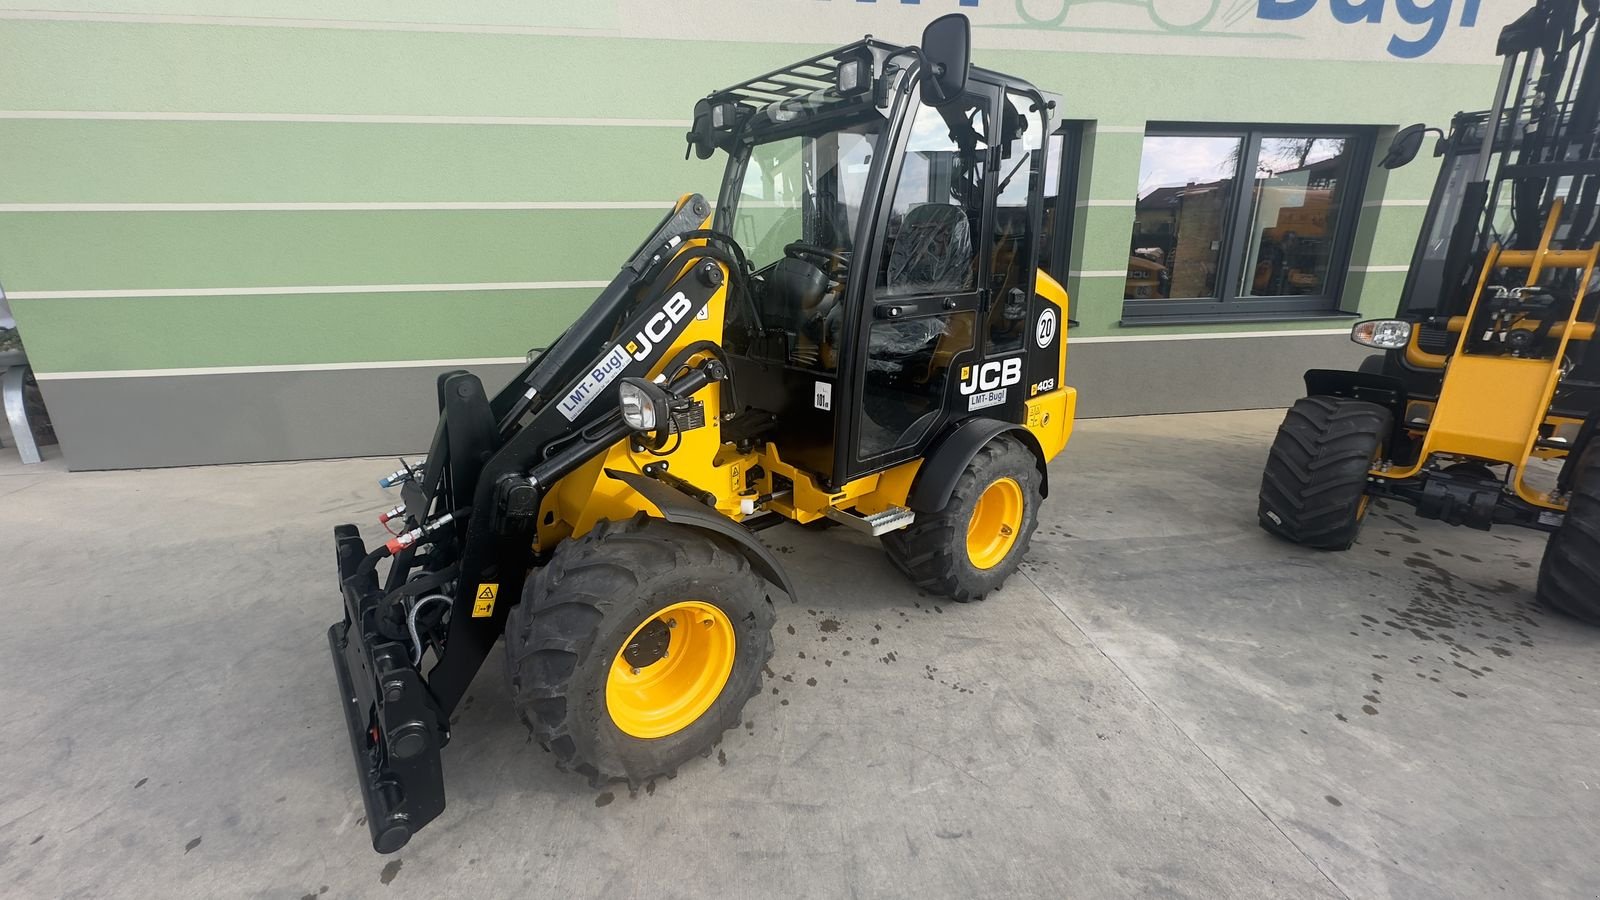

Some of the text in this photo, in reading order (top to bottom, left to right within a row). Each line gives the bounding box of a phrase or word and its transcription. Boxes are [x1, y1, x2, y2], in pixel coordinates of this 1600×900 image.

[633, 291, 692, 362] JCB
[1039, 318, 1052, 339] 20
[563, 382, 593, 412] LMT-
[591, 350, 624, 383] Bugl
[960, 357, 1022, 395] JCB
[1037, 378, 1054, 391] 403
[988, 390, 1005, 402] Bugl
